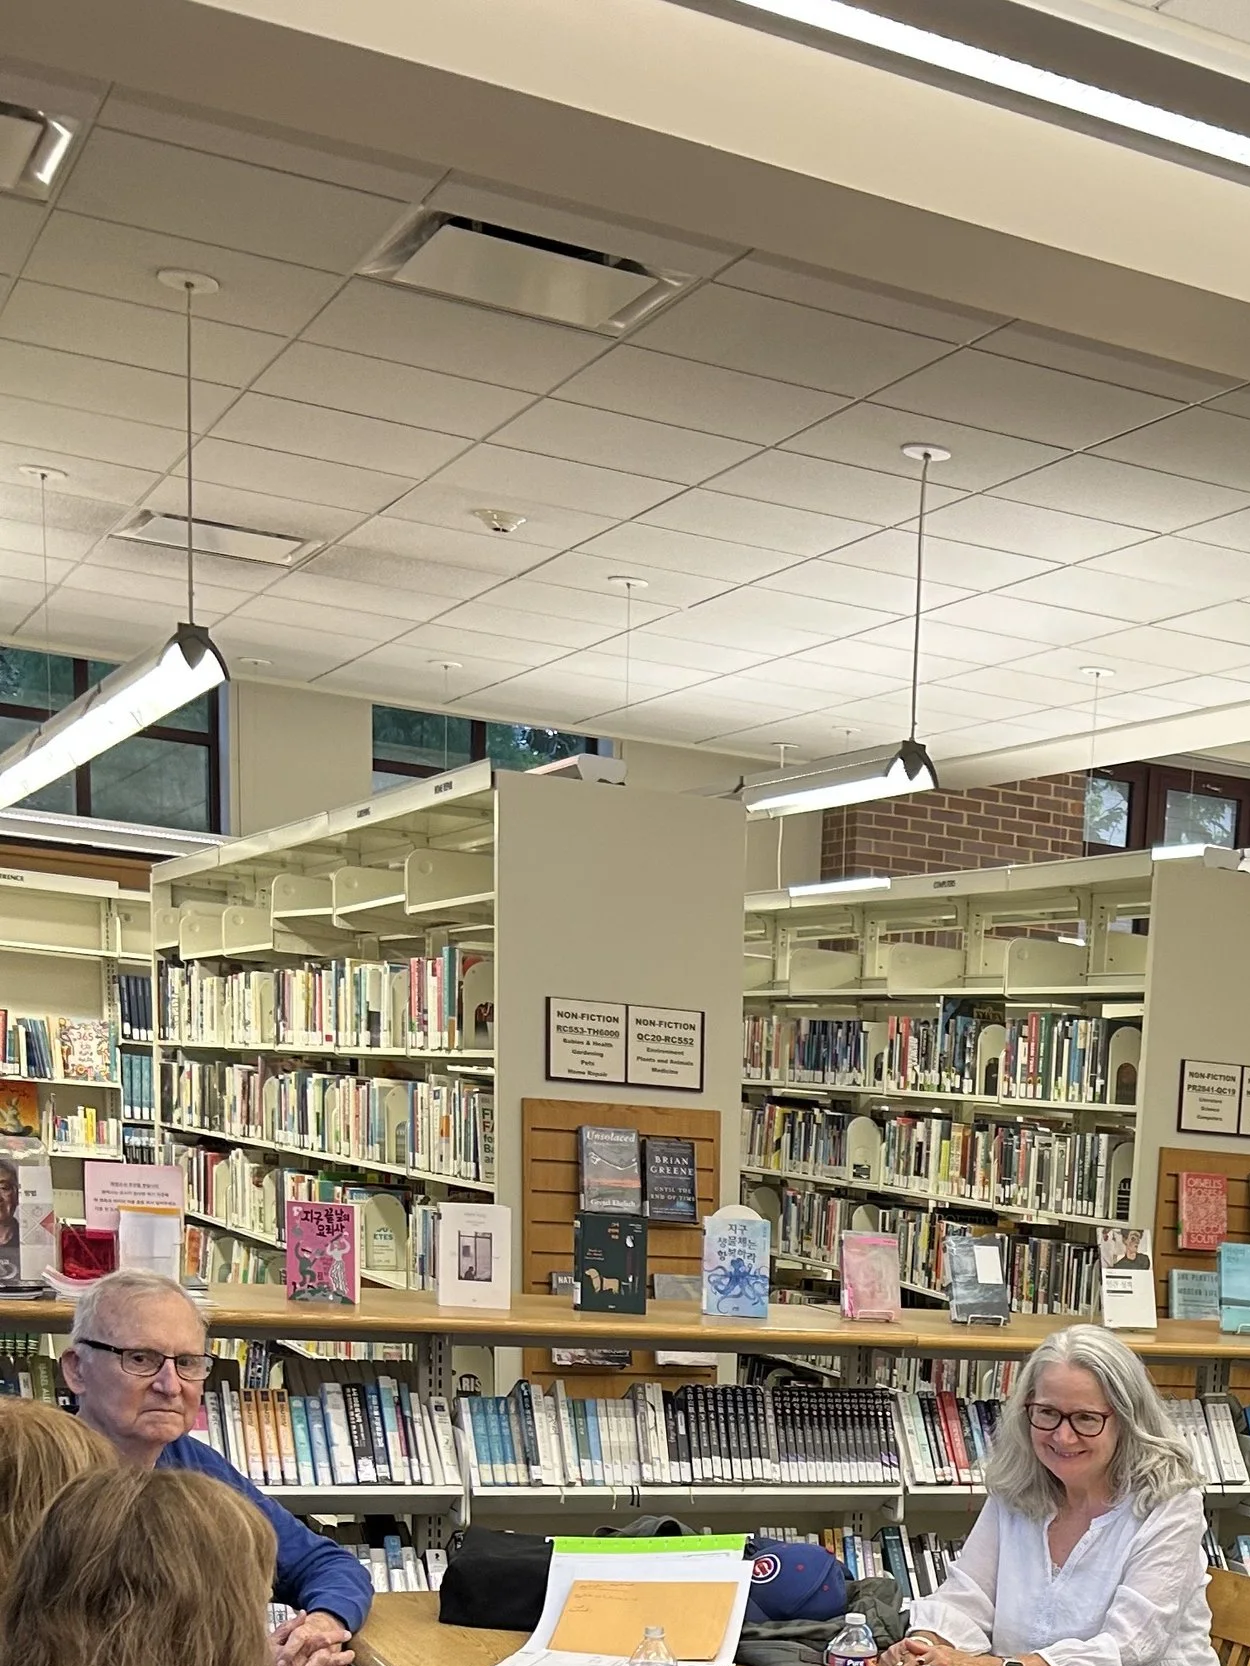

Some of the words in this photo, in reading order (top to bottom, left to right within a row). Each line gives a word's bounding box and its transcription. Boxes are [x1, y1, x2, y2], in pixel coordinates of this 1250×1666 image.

[556, 1010, 620, 1024] NON-FICTION
[556, 1024, 620, 1038] RC553-TH6000
[635, 1018, 696, 1031] NON-FICTION
[636, 1032, 695, 1046] QC20-RC552
[1188, 1071, 1236, 1082] NON-FICTION
[586, 1130, 637, 1143] Unsolaced
[655, 1155, 690, 1166] BRIAN
[649, 1164, 695, 1176] GREENE
[300, 1209, 324, 1226] 지구
[727, 1223, 748, 1235] 지구
